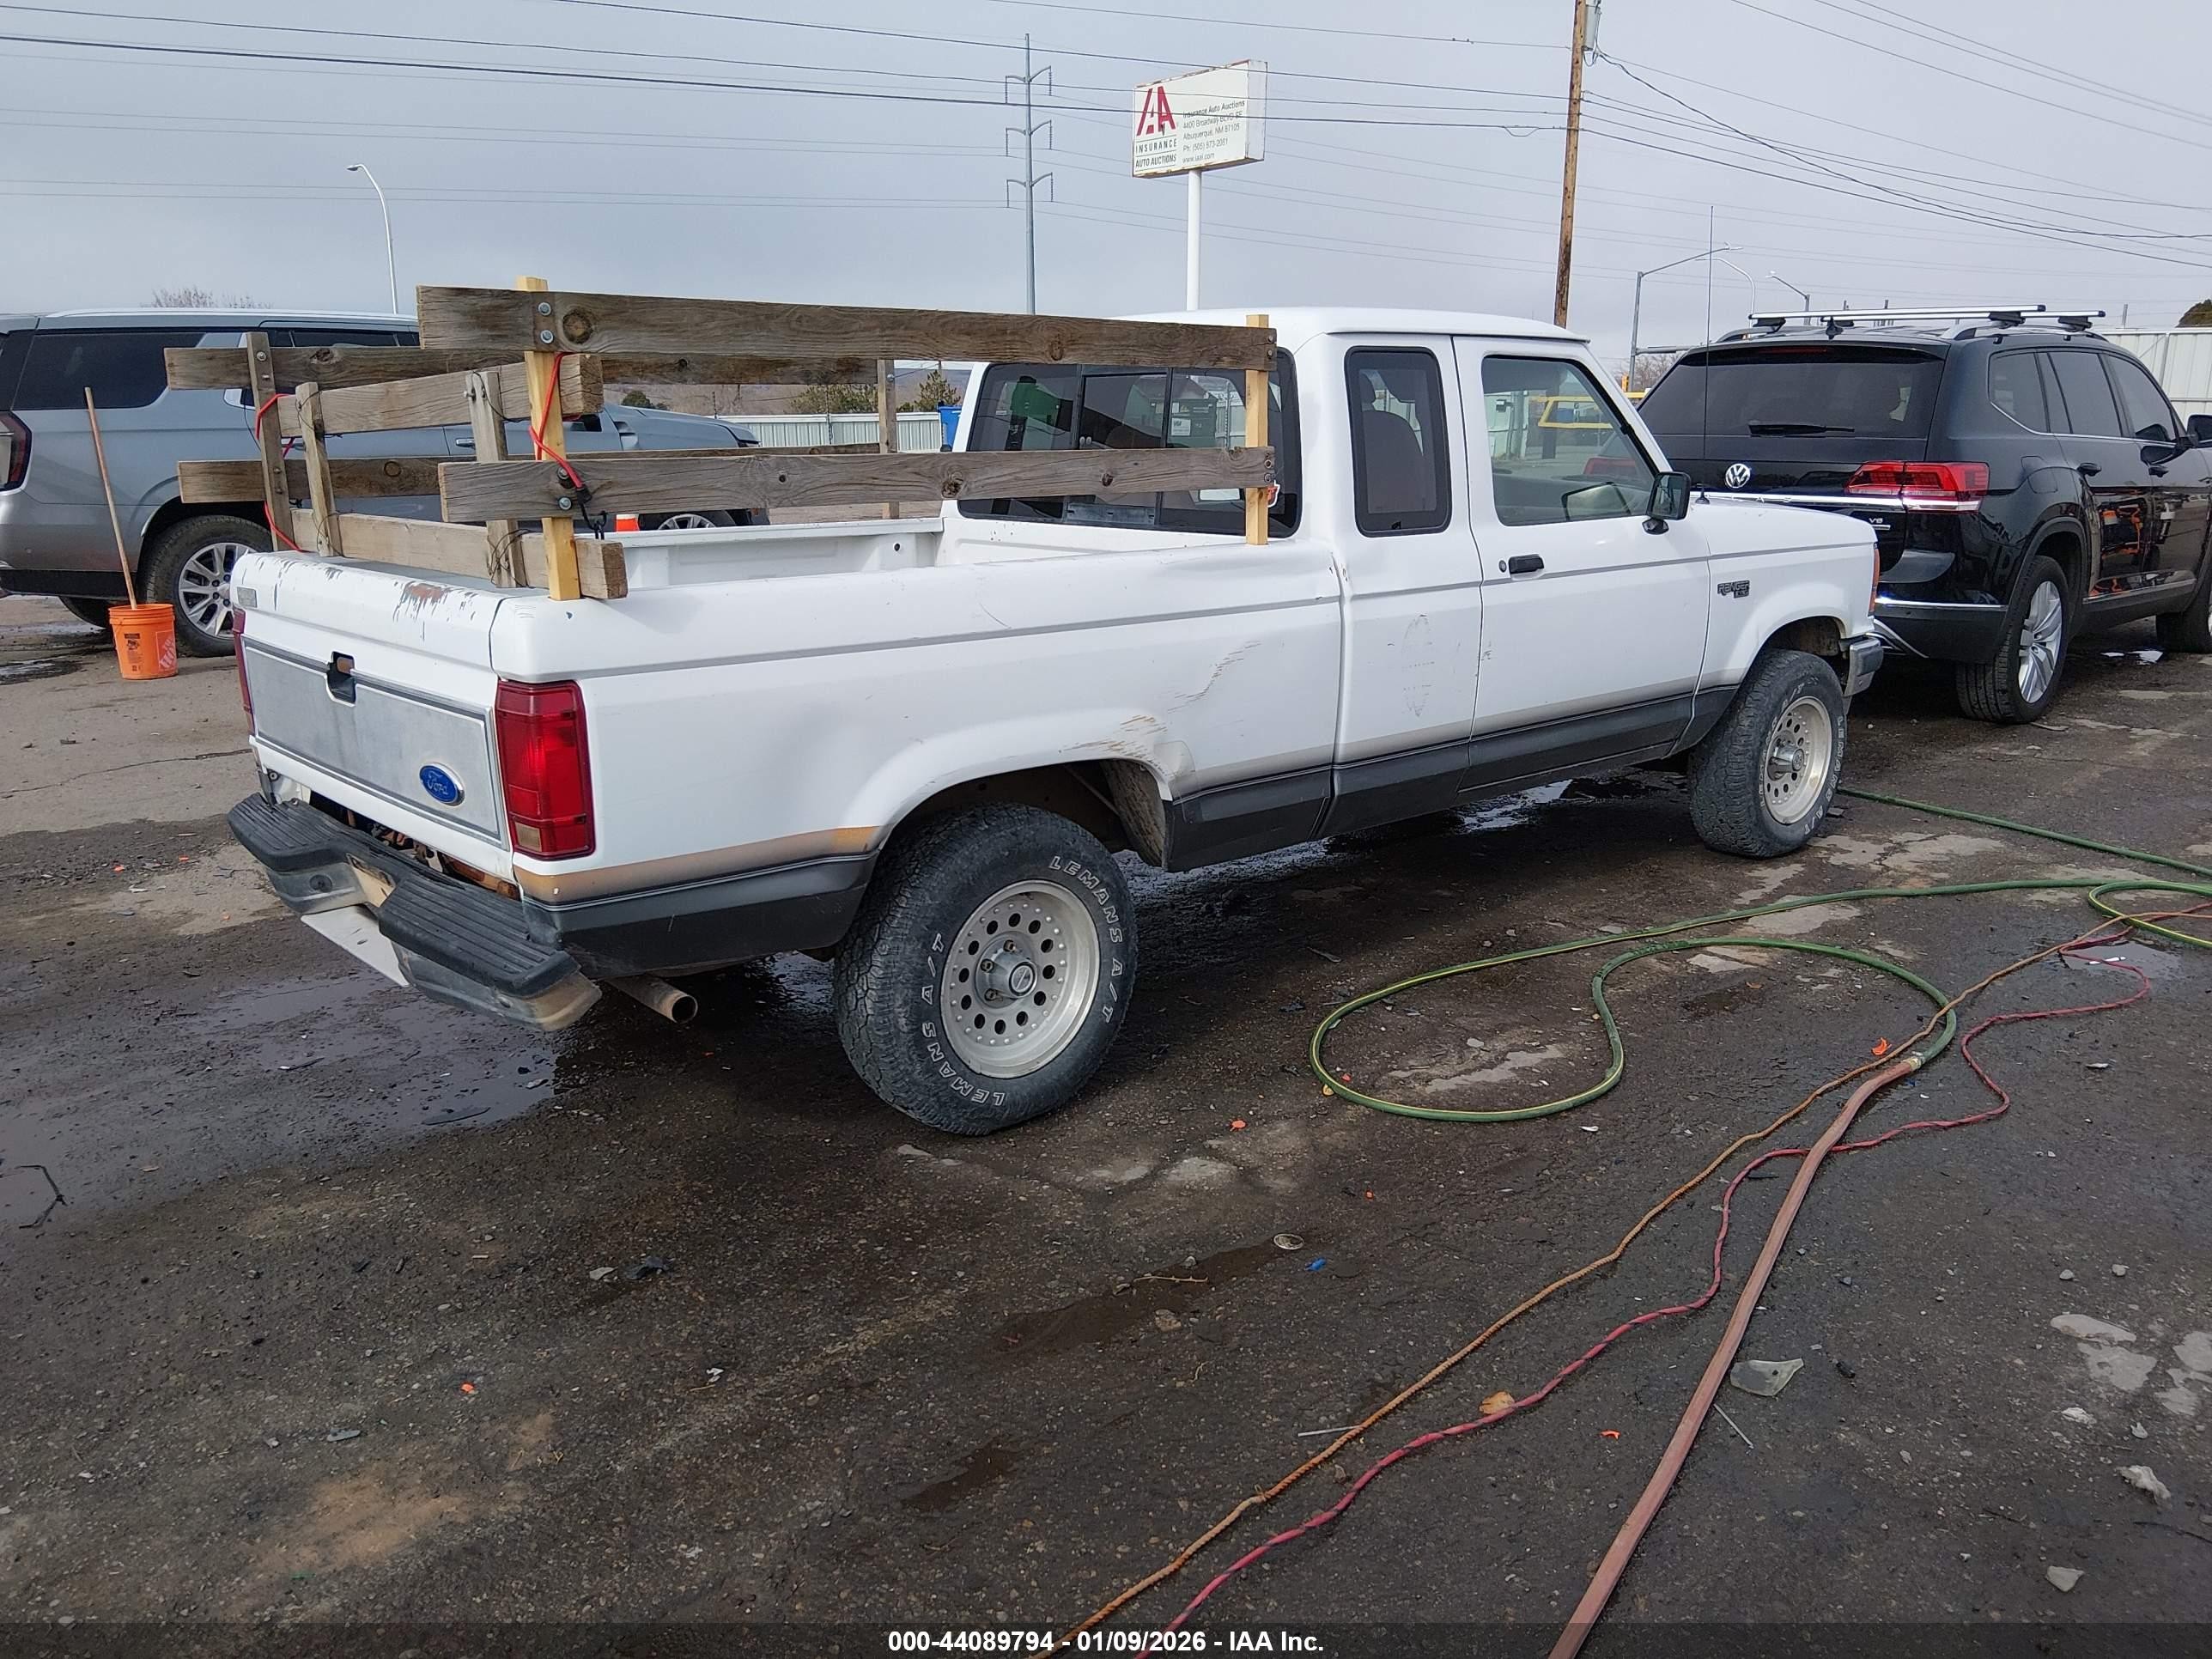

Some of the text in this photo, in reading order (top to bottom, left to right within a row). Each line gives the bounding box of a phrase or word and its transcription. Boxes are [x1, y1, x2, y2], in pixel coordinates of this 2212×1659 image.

[1183, 109, 1207, 118] Insurance
[1222, 100, 1244, 109] Auctions
[1183, 120, 1194, 129] 4400
[1196, 117, 1219, 128] Broadway
[1183, 130, 1213, 140] Albuquerque,
[1136, 140, 1176, 153] INSURANCE
[1135, 154, 1176, 168] AUTO AUCTIONS
[1824, 715, 1845, 802] LEMANS
[427, 769, 449, 795] Ford
[1048, 855, 1123, 945] LEMANS
[921, 1021, 1006, 1107] LEMANS
